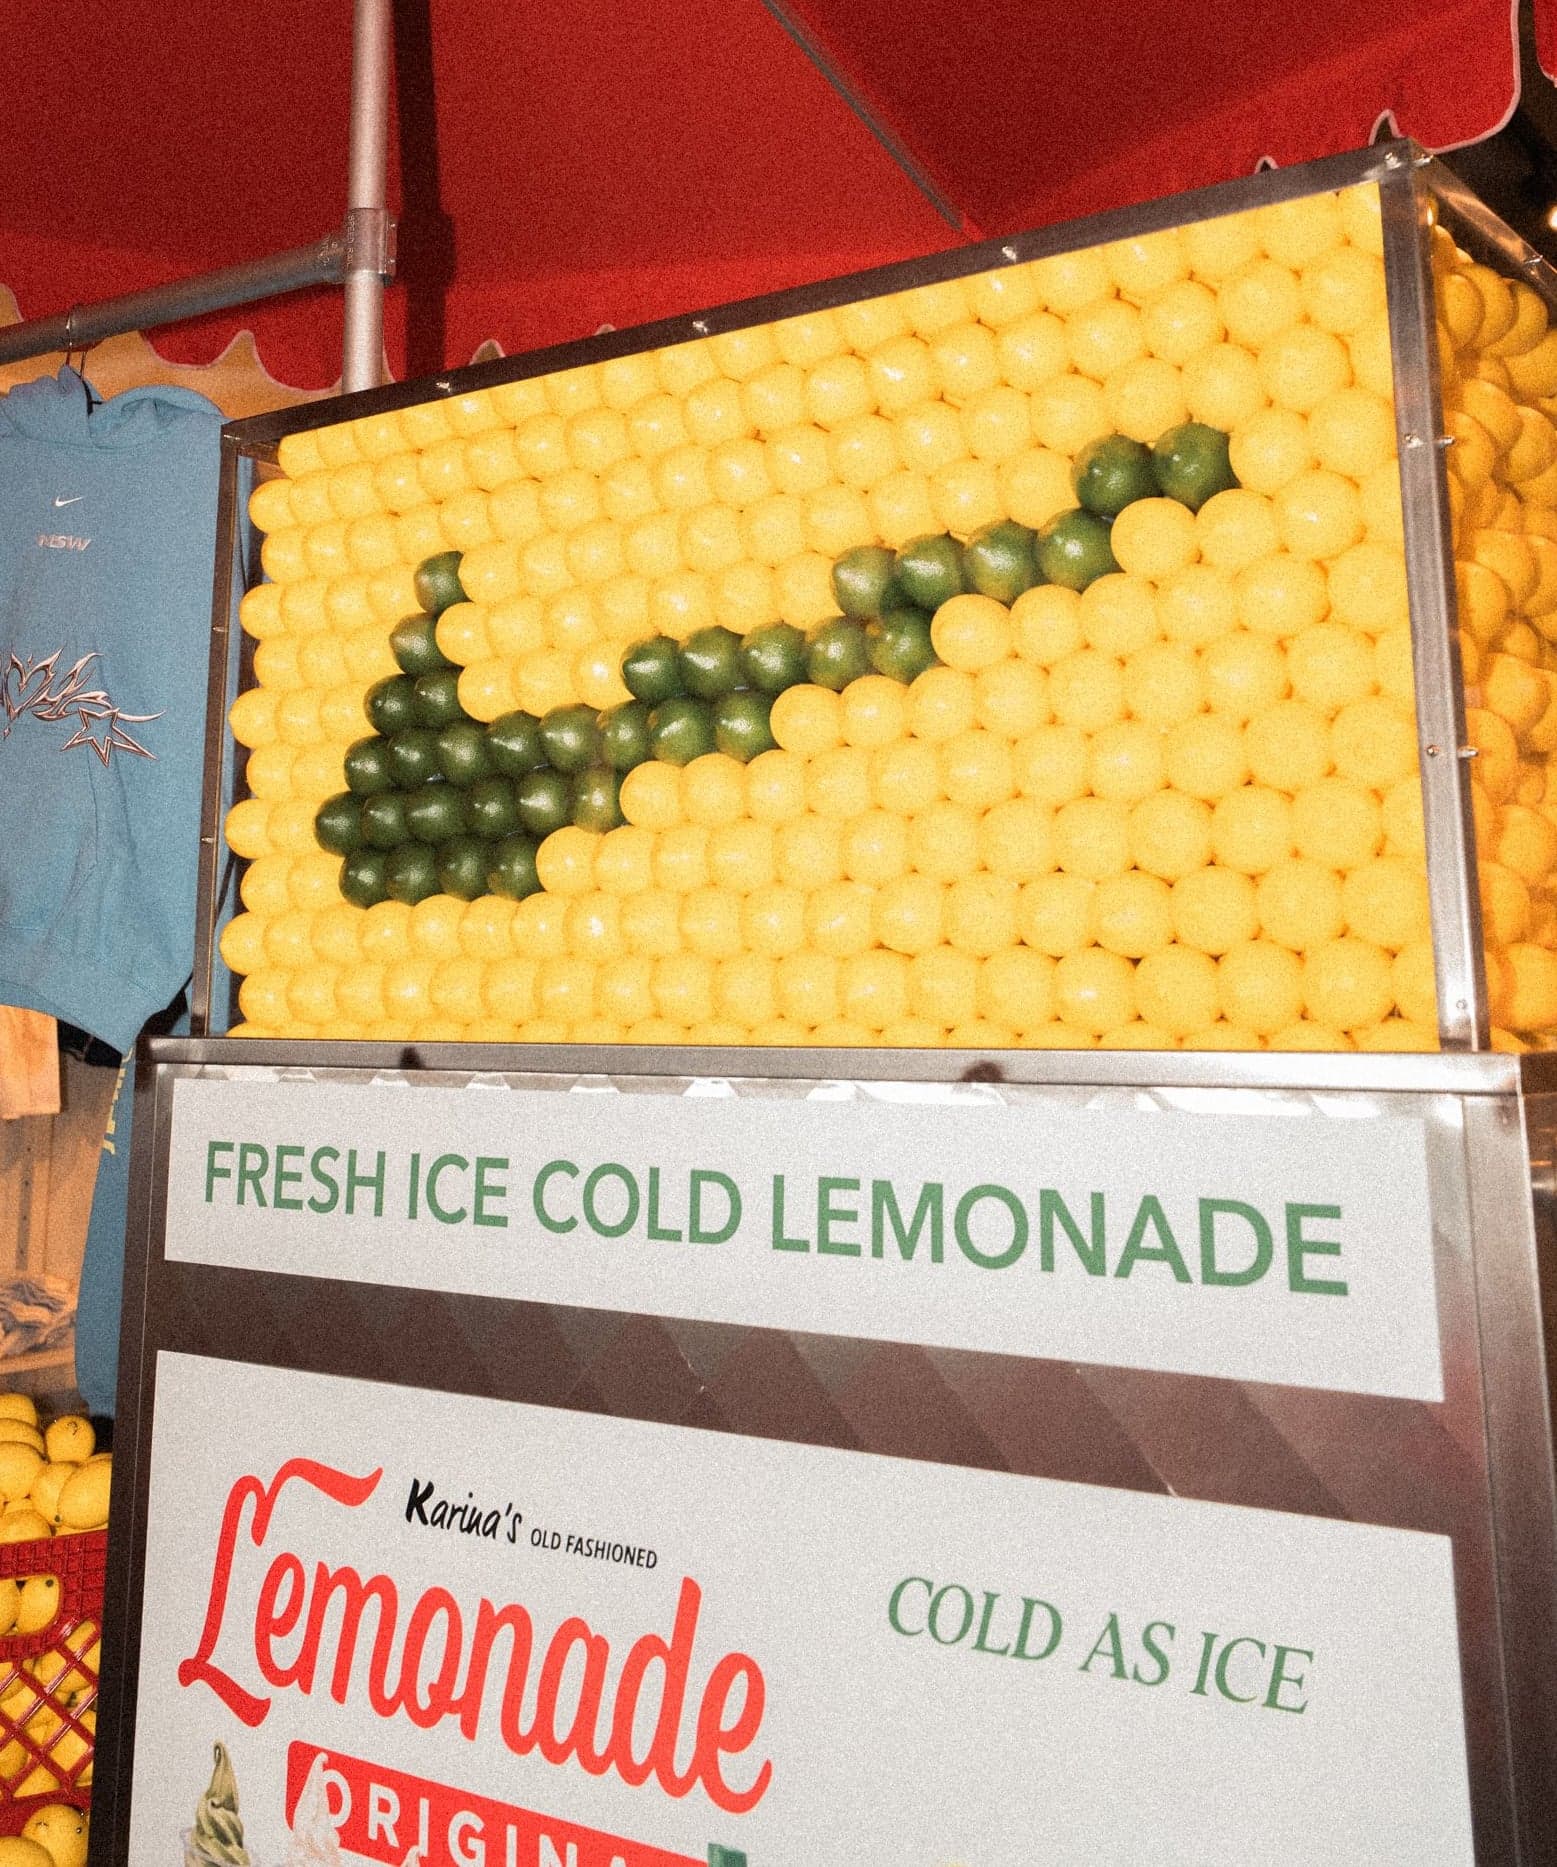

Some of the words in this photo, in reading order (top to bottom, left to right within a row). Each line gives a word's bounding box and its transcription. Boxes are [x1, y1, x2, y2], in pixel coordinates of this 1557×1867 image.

[207, 1142, 385, 1216] FRESH
[409, 1153, 508, 1228] ICE
[533, 1160, 742, 1245] COLD
[772, 1174, 1349, 1296] LEMONADE
[405, 1478, 522, 1544] Karina's
[530, 1528, 561, 1551] OLD
[565, 1534, 658, 1570] FASHIONED
[178, 1458, 772, 1814] Lemonade
[887, 1577, 1063, 1661] COLD
[1079, 1613, 1176, 1687] AS
[1190, 1632, 1315, 1714] ICE
[321, 1768, 628, 1867] ORIGIN
